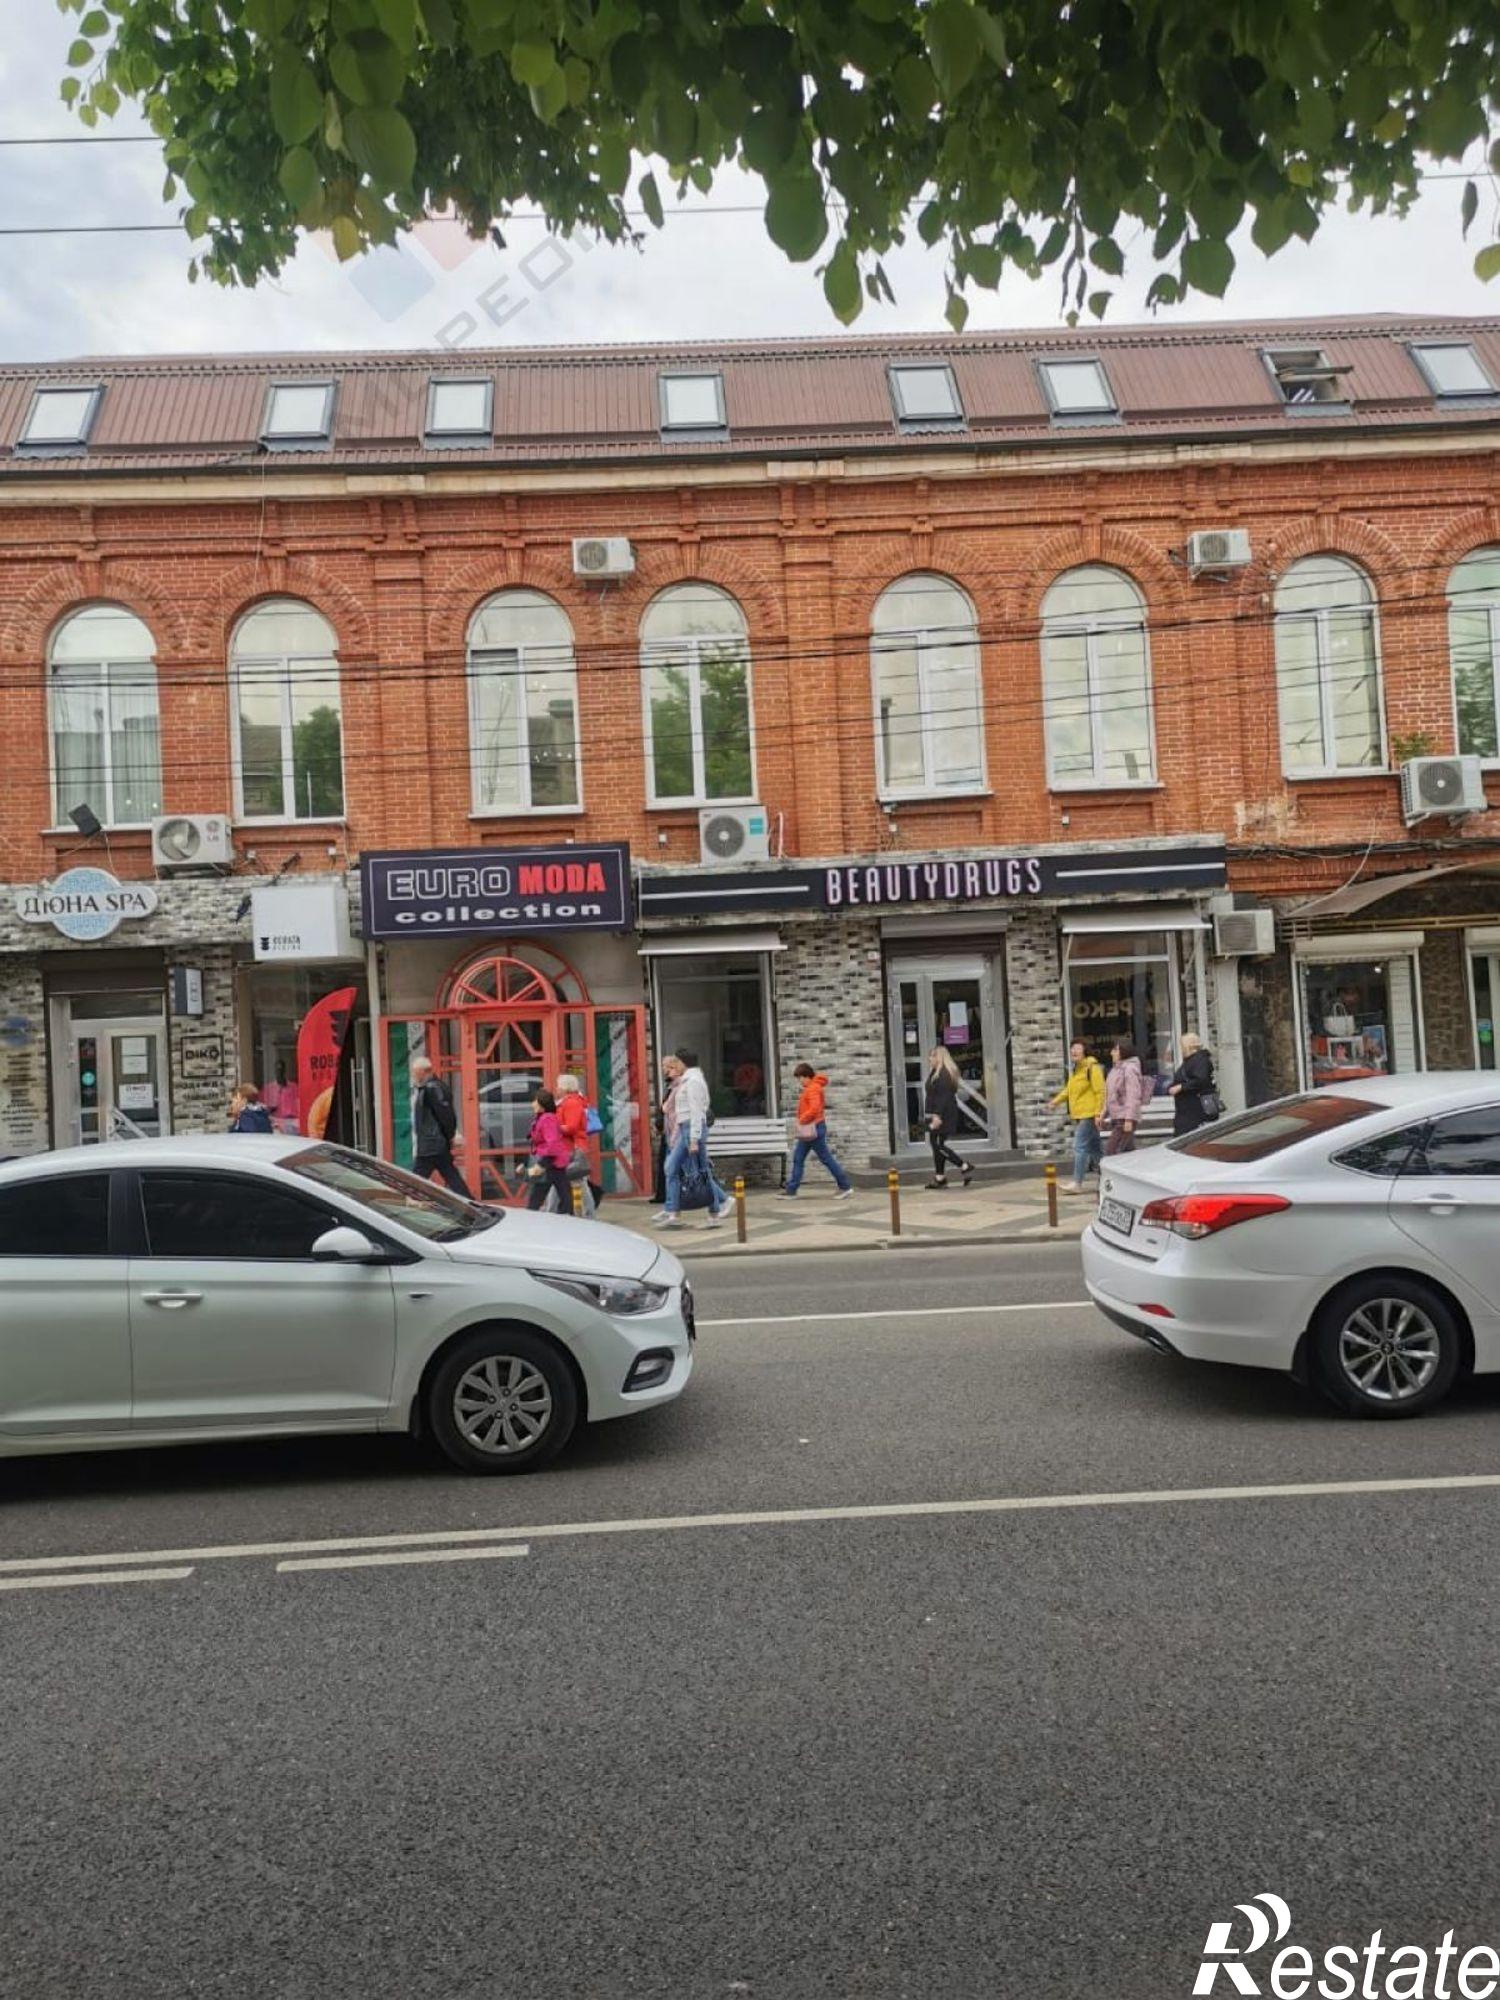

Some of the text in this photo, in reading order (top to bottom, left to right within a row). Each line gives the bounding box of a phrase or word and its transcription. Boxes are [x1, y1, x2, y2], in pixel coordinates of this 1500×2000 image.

[386, 861, 606, 901] EURO MODA
[825, 858, 1043, 906] BEAUTYDRUGS
[23, 890, 149, 916] ДЮНА SPA
[395, 902, 602, 925] collection
